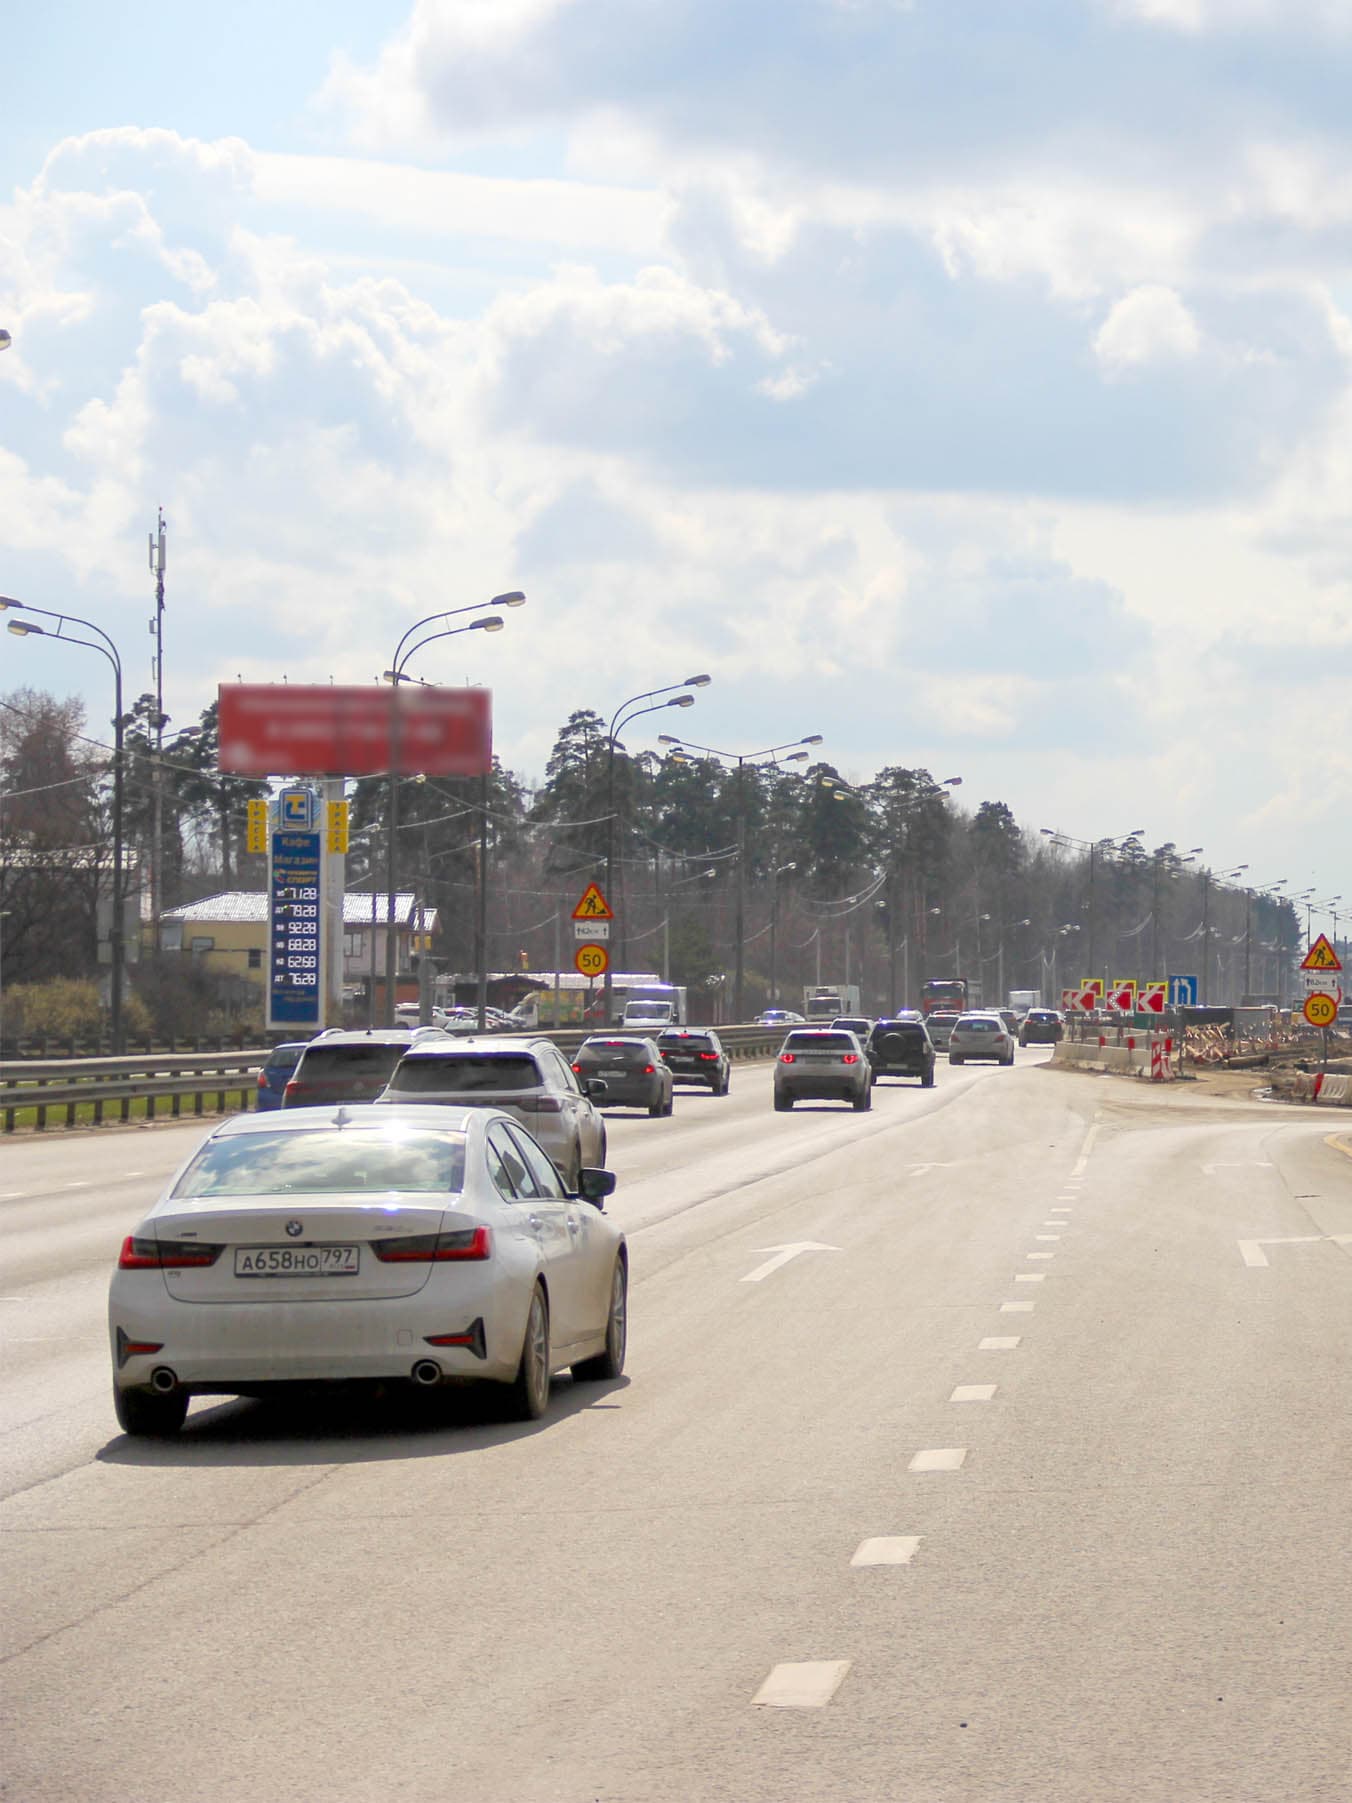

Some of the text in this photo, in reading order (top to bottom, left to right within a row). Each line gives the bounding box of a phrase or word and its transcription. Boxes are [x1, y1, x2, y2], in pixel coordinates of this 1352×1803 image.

[582, 953, 601, 967] 50
[1311, 1003, 1329, 1016] 50
[322, 1249, 352, 1265] 797
